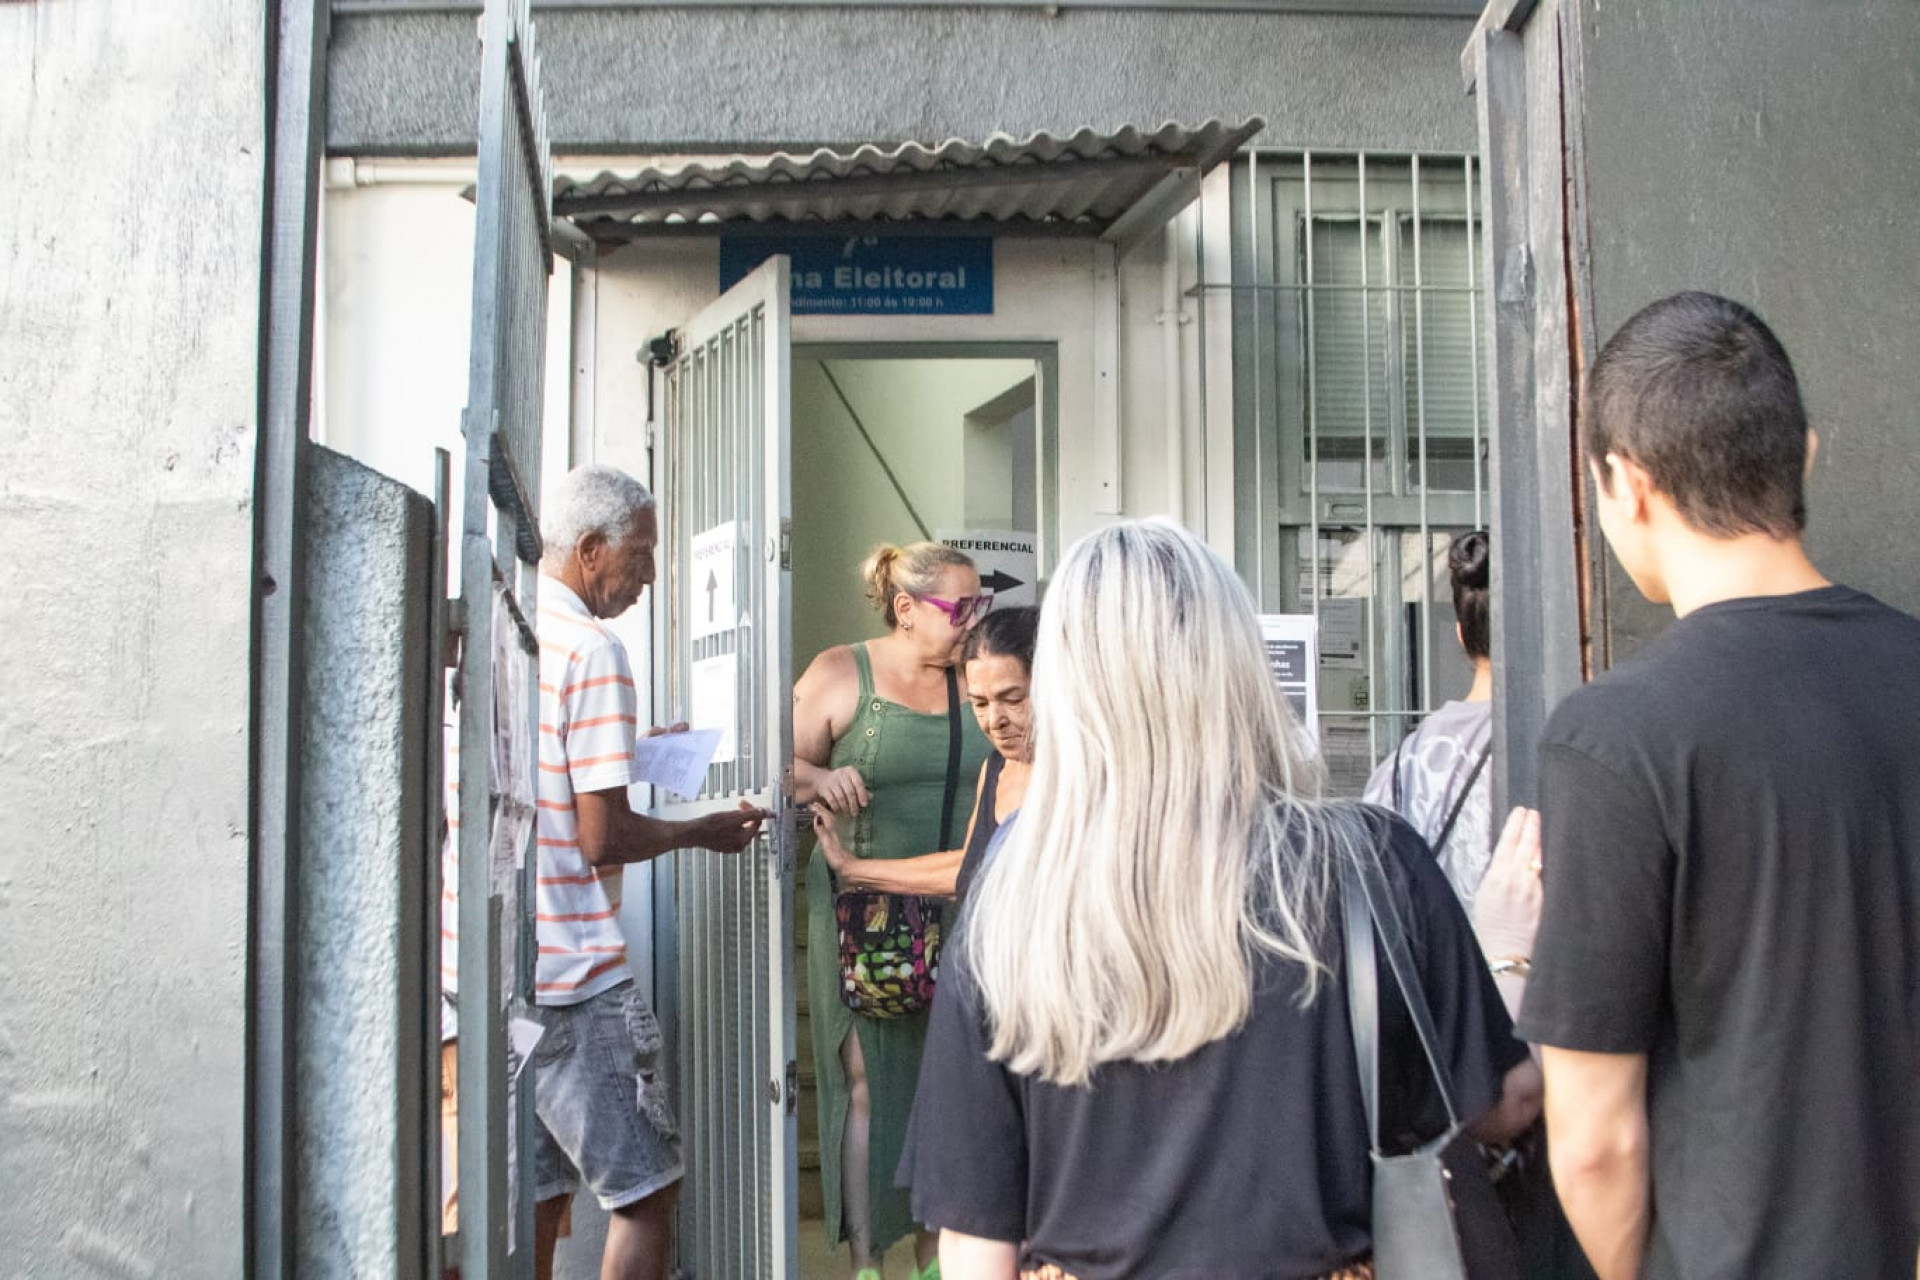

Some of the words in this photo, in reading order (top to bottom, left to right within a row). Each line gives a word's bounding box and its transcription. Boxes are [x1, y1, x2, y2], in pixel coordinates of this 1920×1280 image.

[790, 271, 822, 289] na
[834, 267, 966, 289] Eleitoral
[942, 539, 1034, 554] PREFERENCIAL
